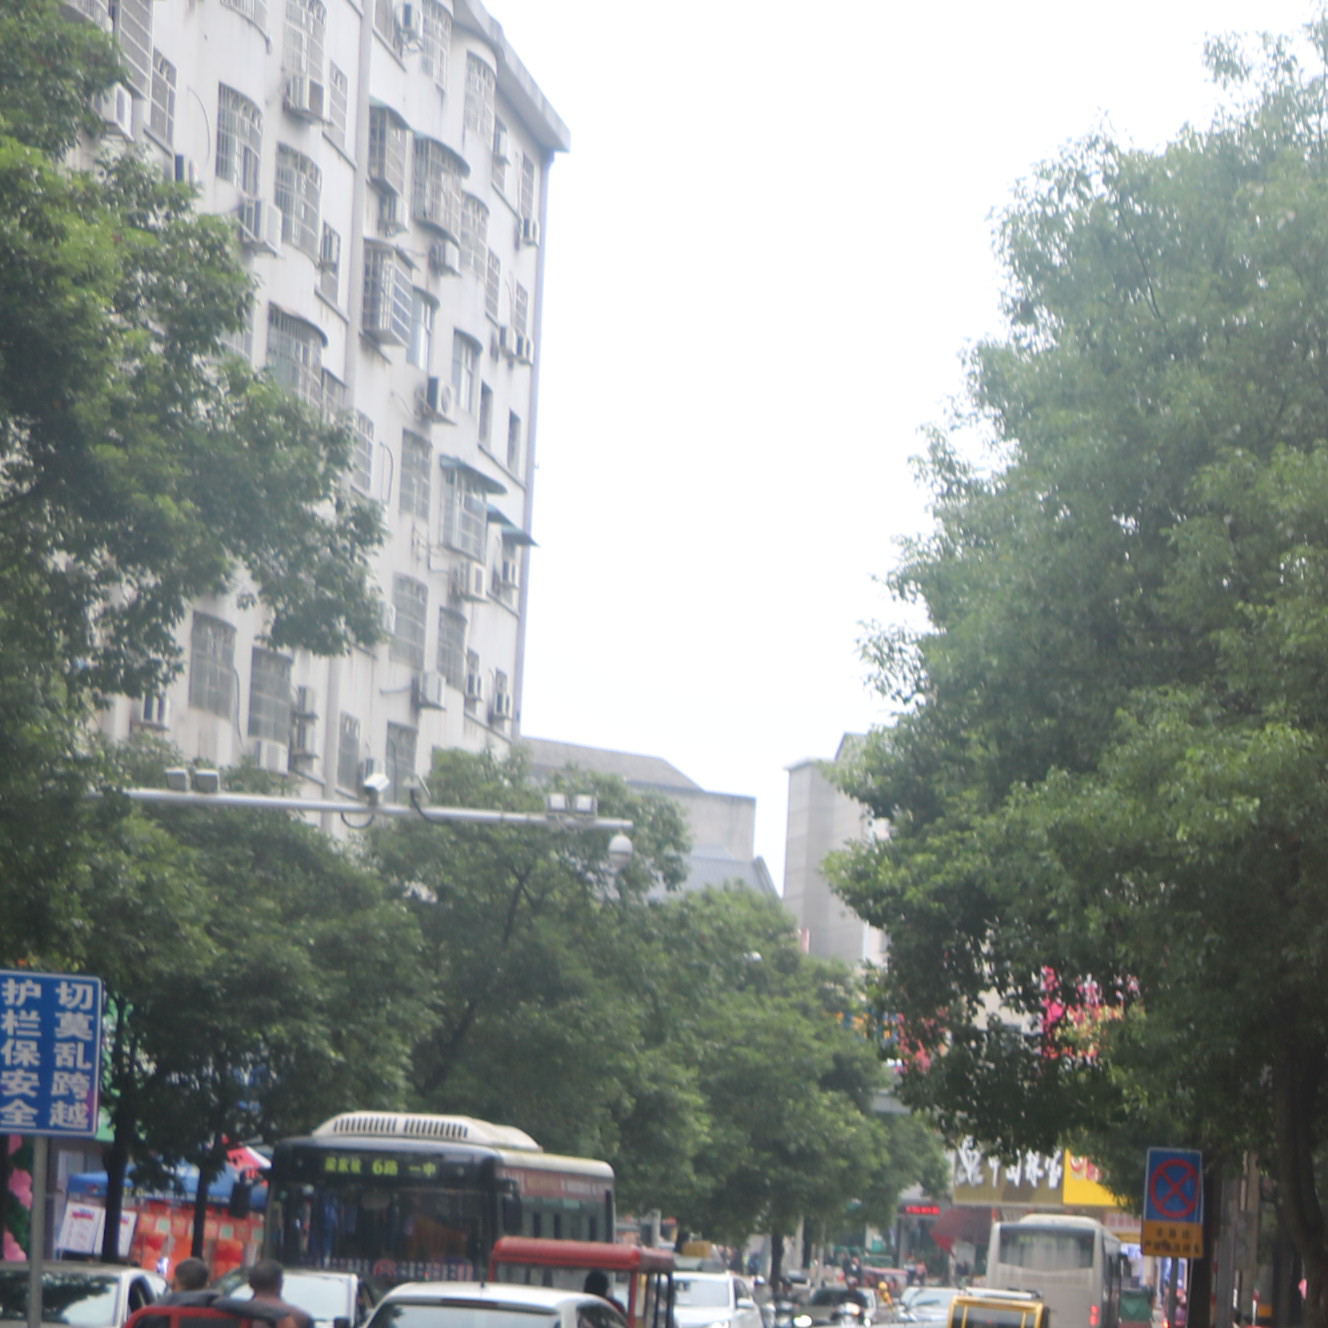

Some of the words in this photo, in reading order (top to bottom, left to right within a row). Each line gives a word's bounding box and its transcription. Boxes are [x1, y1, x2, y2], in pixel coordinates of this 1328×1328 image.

[1, 978, 42, 1128] 护栏保安全
[50, 980, 94, 1129] 切莫乱跨越
